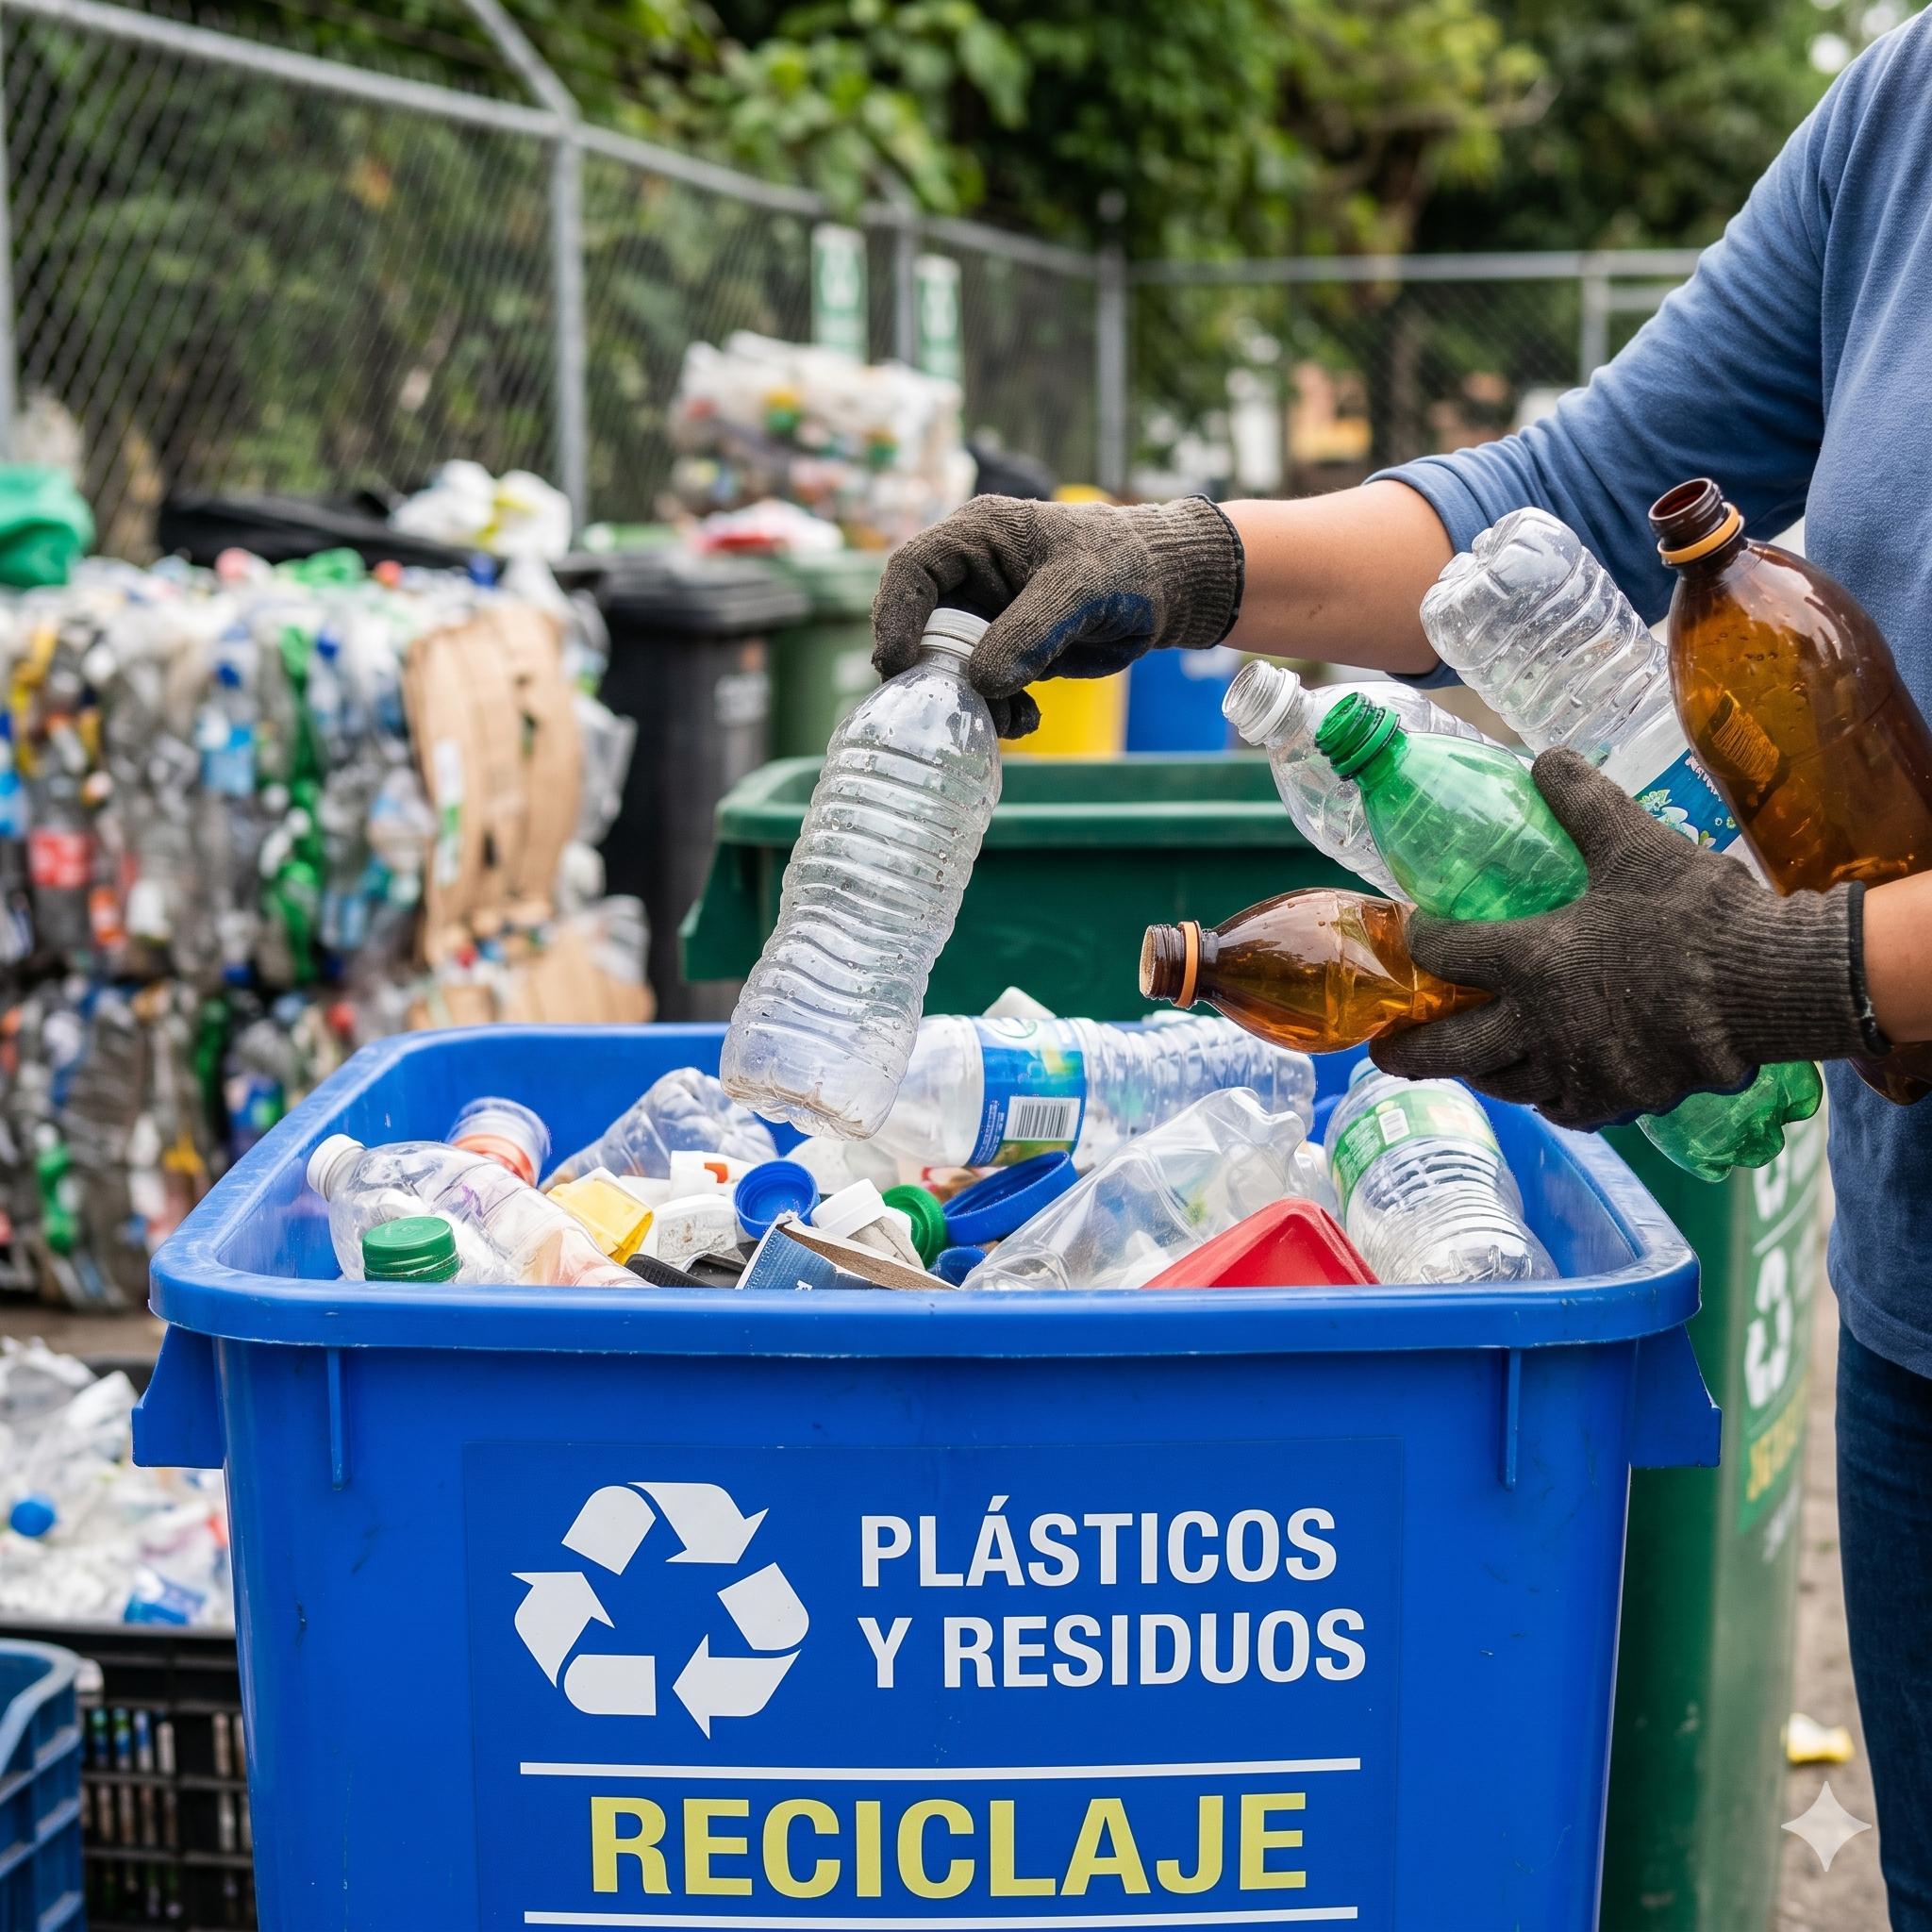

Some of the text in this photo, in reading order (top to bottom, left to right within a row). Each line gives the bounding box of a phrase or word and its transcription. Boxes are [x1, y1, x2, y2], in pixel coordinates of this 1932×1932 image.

[860, 1494, 1338, 1588] PLÁSTICOS
[857, 1607, 1367, 1690] Y RESIDUOS
[590, 1791, 1307, 1899] RECICLAJE
